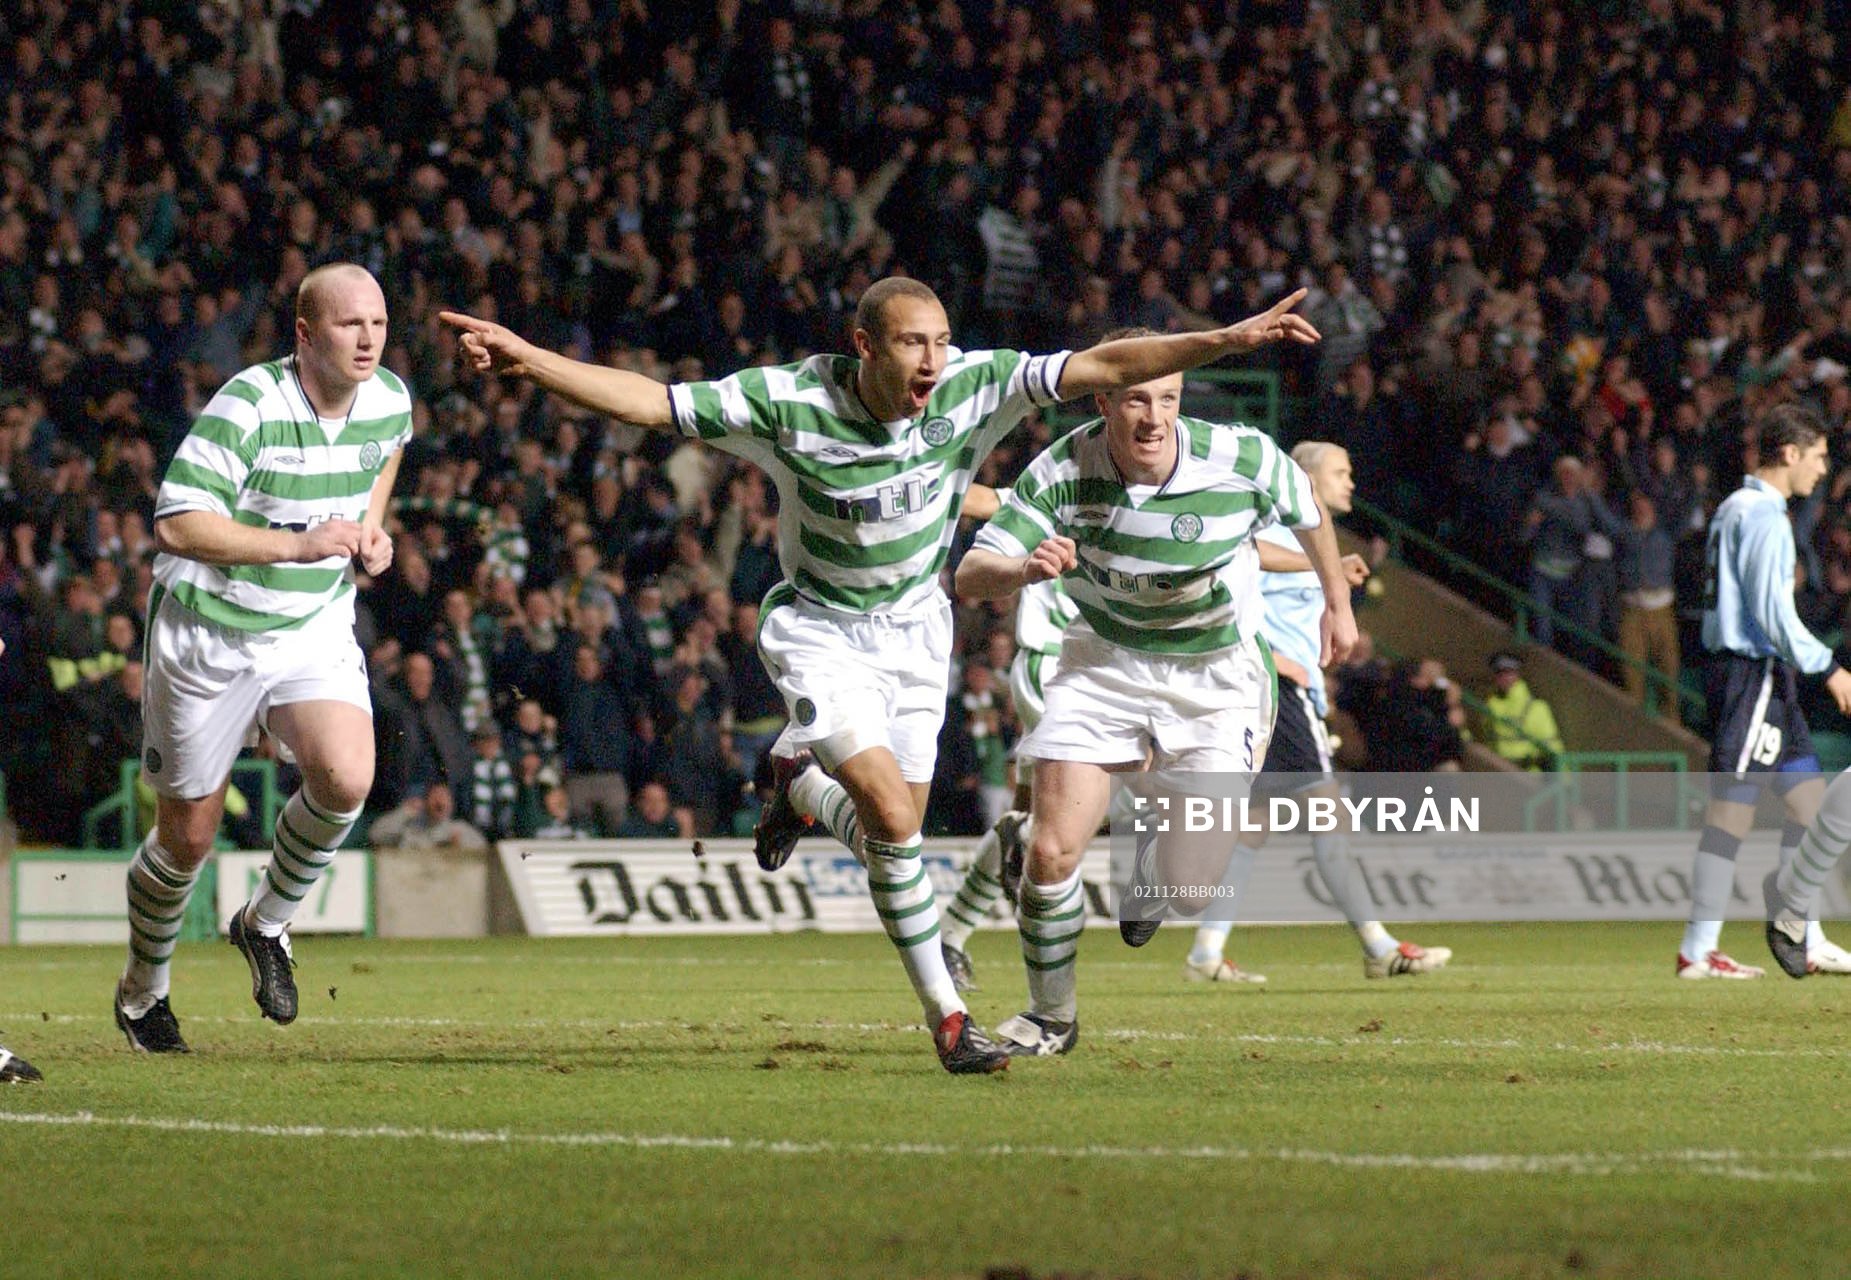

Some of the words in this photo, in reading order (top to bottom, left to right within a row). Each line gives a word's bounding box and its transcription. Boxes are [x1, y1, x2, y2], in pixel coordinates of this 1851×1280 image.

[1243, 726, 1254, 772] 5
[1752, 721, 1782, 766] 19
[569, 860, 818, 927] Daily
